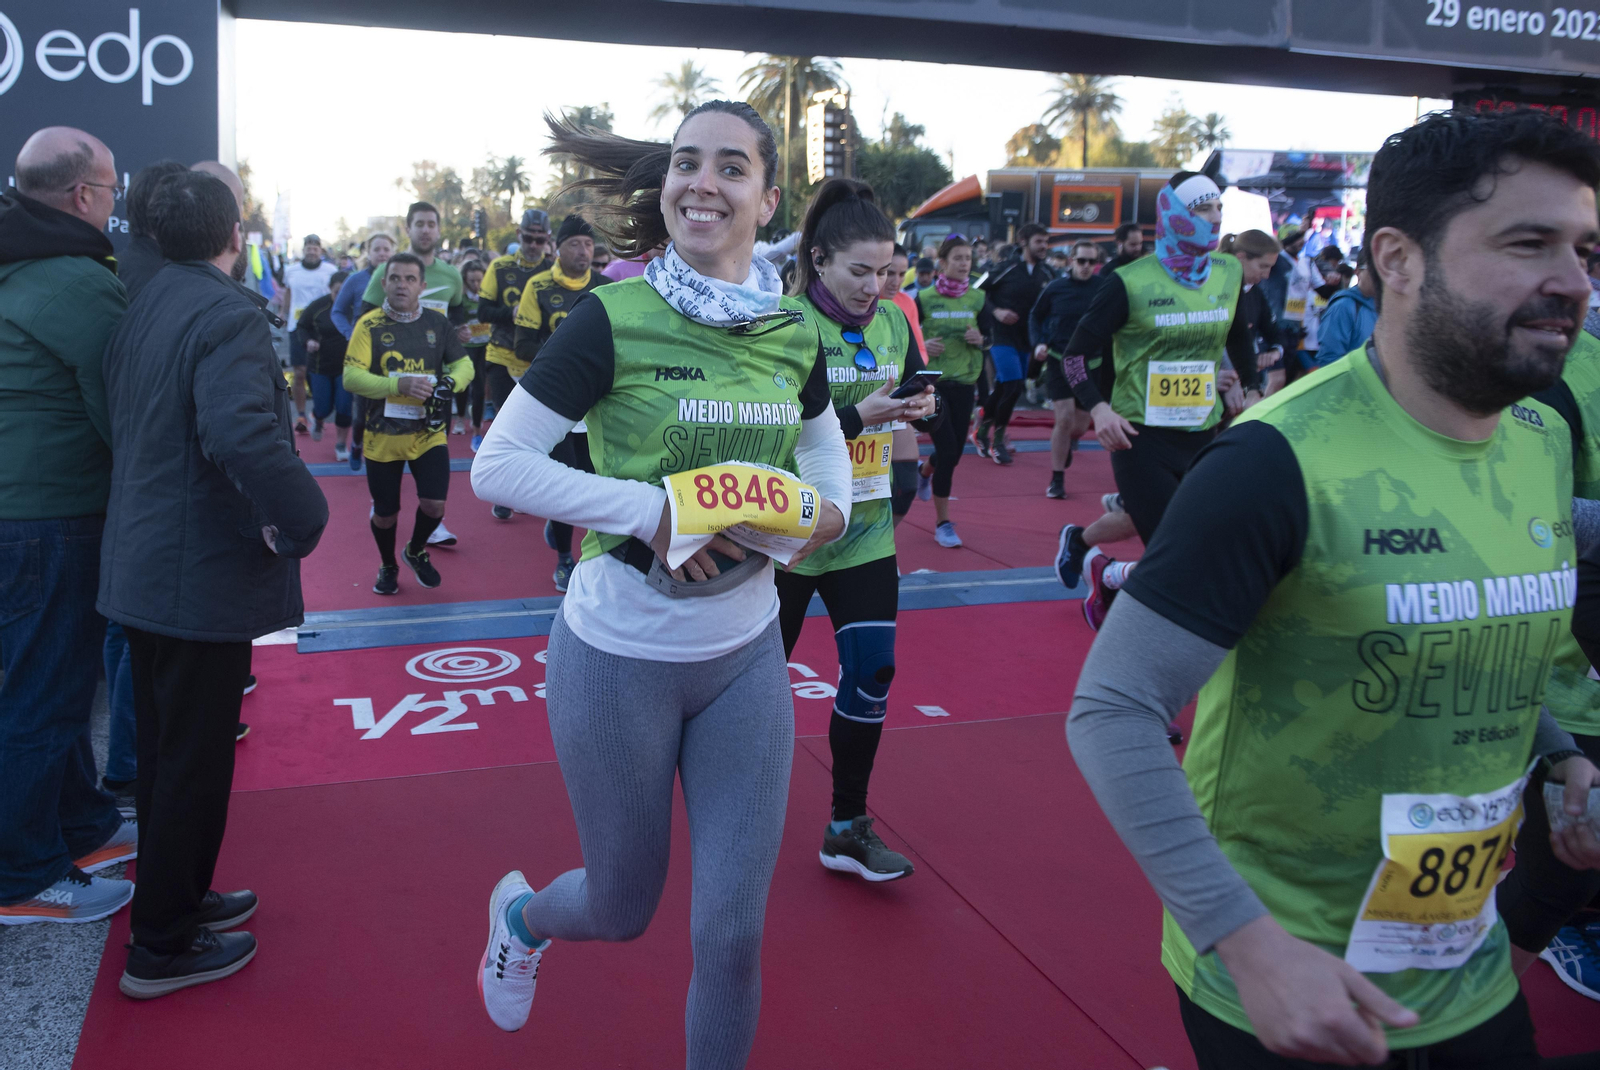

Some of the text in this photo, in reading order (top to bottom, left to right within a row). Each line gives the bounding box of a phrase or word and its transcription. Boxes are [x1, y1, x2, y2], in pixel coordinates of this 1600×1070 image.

[1425, 0, 1460, 27] 29
[1466, 5, 1545, 35] enero
[35, 8, 194, 105] edp
[1155, 306, 1229, 328] MEDIO MARATÓN
[823, 346, 844, 357] OKA
[655, 366, 708, 382] HOKA
[1159, 378, 1201, 397] 9132
[678, 397, 734, 425] MEDIO
[1511, 403, 1545, 428] 023
[693, 472, 790, 514] 8846
[1363, 528, 1448, 555] HOKA
[1385, 579, 1480, 625] MEDIO
[1436, 802, 1476, 827] edp
[34, 888, 74, 906] OKA
